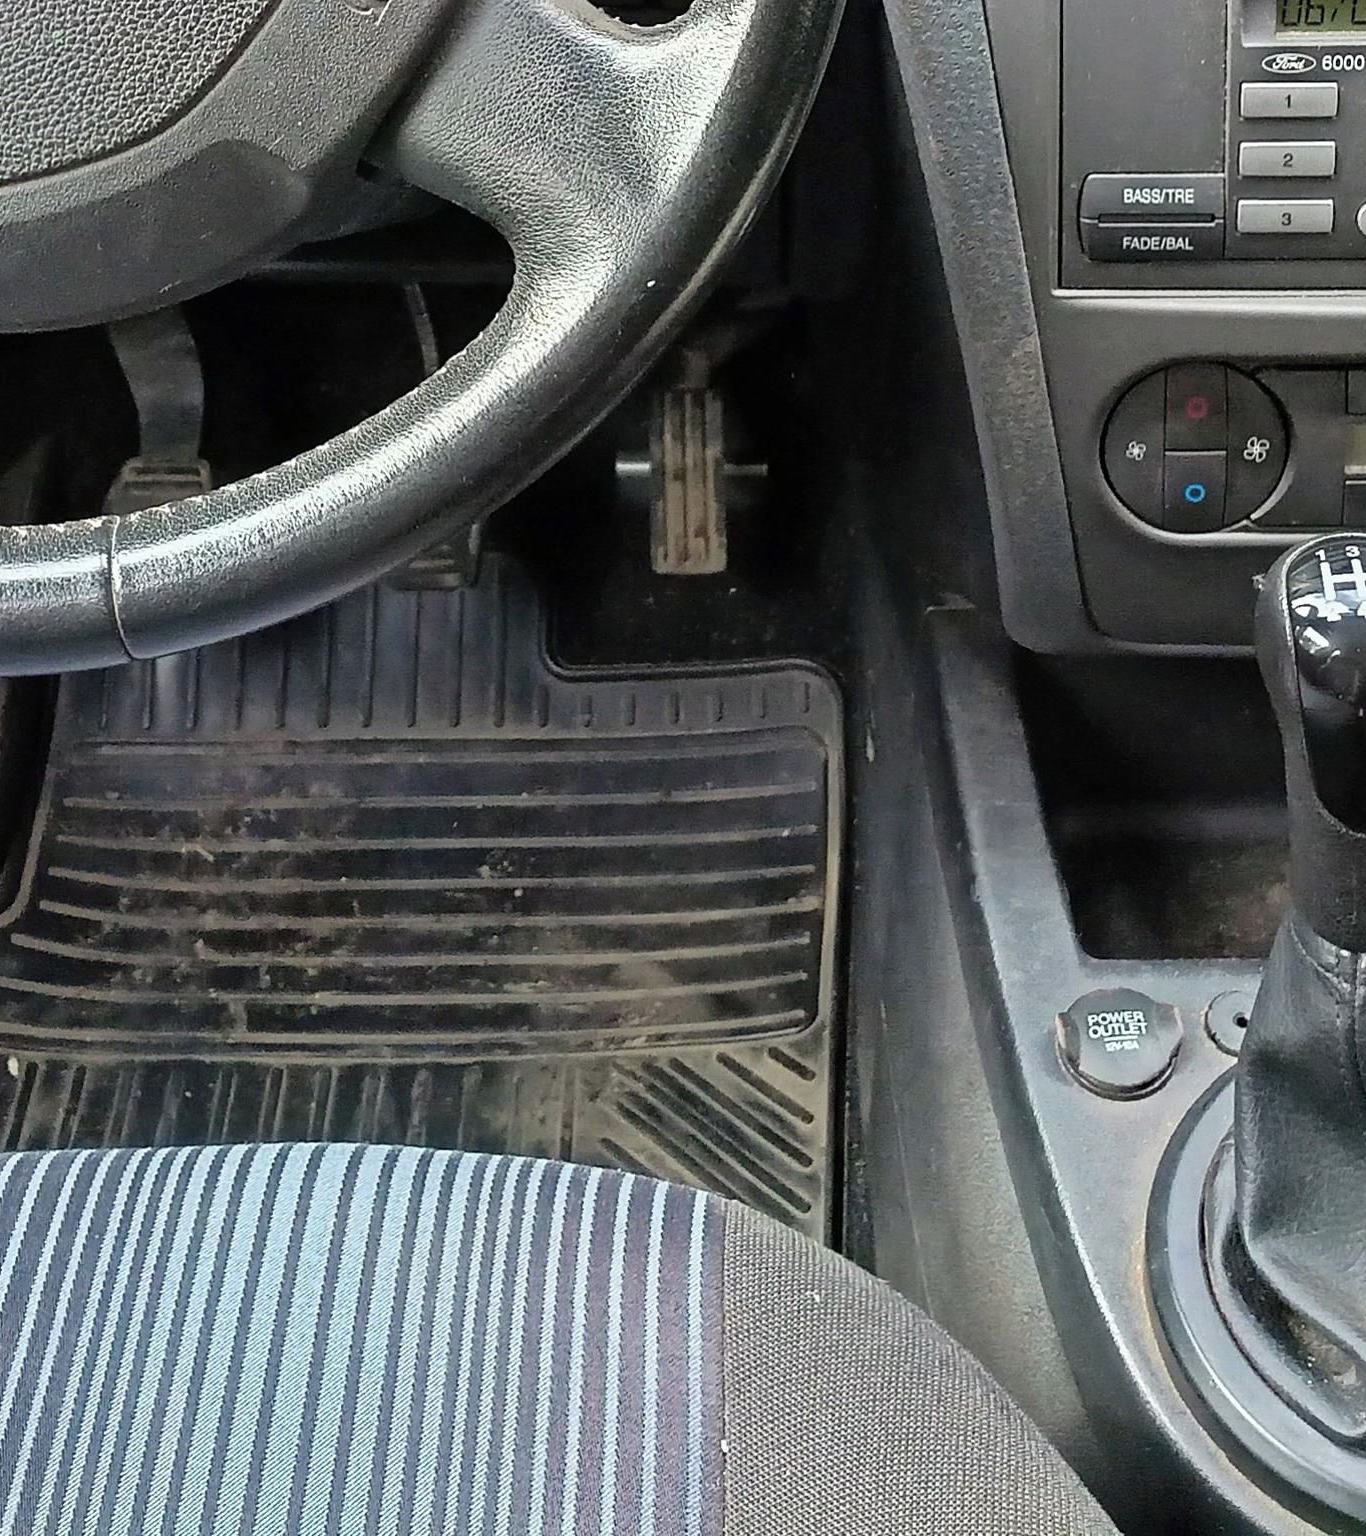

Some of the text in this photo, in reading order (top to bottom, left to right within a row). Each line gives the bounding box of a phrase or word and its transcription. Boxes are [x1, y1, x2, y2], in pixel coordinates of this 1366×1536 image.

[1321, 53, 1365, 71] 6000
[1284, 93, 1292, 109] 1
[1282, 152, 1294, 168] 2
[1122, 187, 1195, 205] BASS/TRE
[1281, 211, 1292, 227] 3
[1122, 236, 1195, 252] FADE/BAL
[1315, 548, 1327, 561] 1
[1344, 545, 1361, 558] 3
[1087, 1010, 1145, 1027] POWER
[1088, 1022, 1148, 1039] OUTLET
